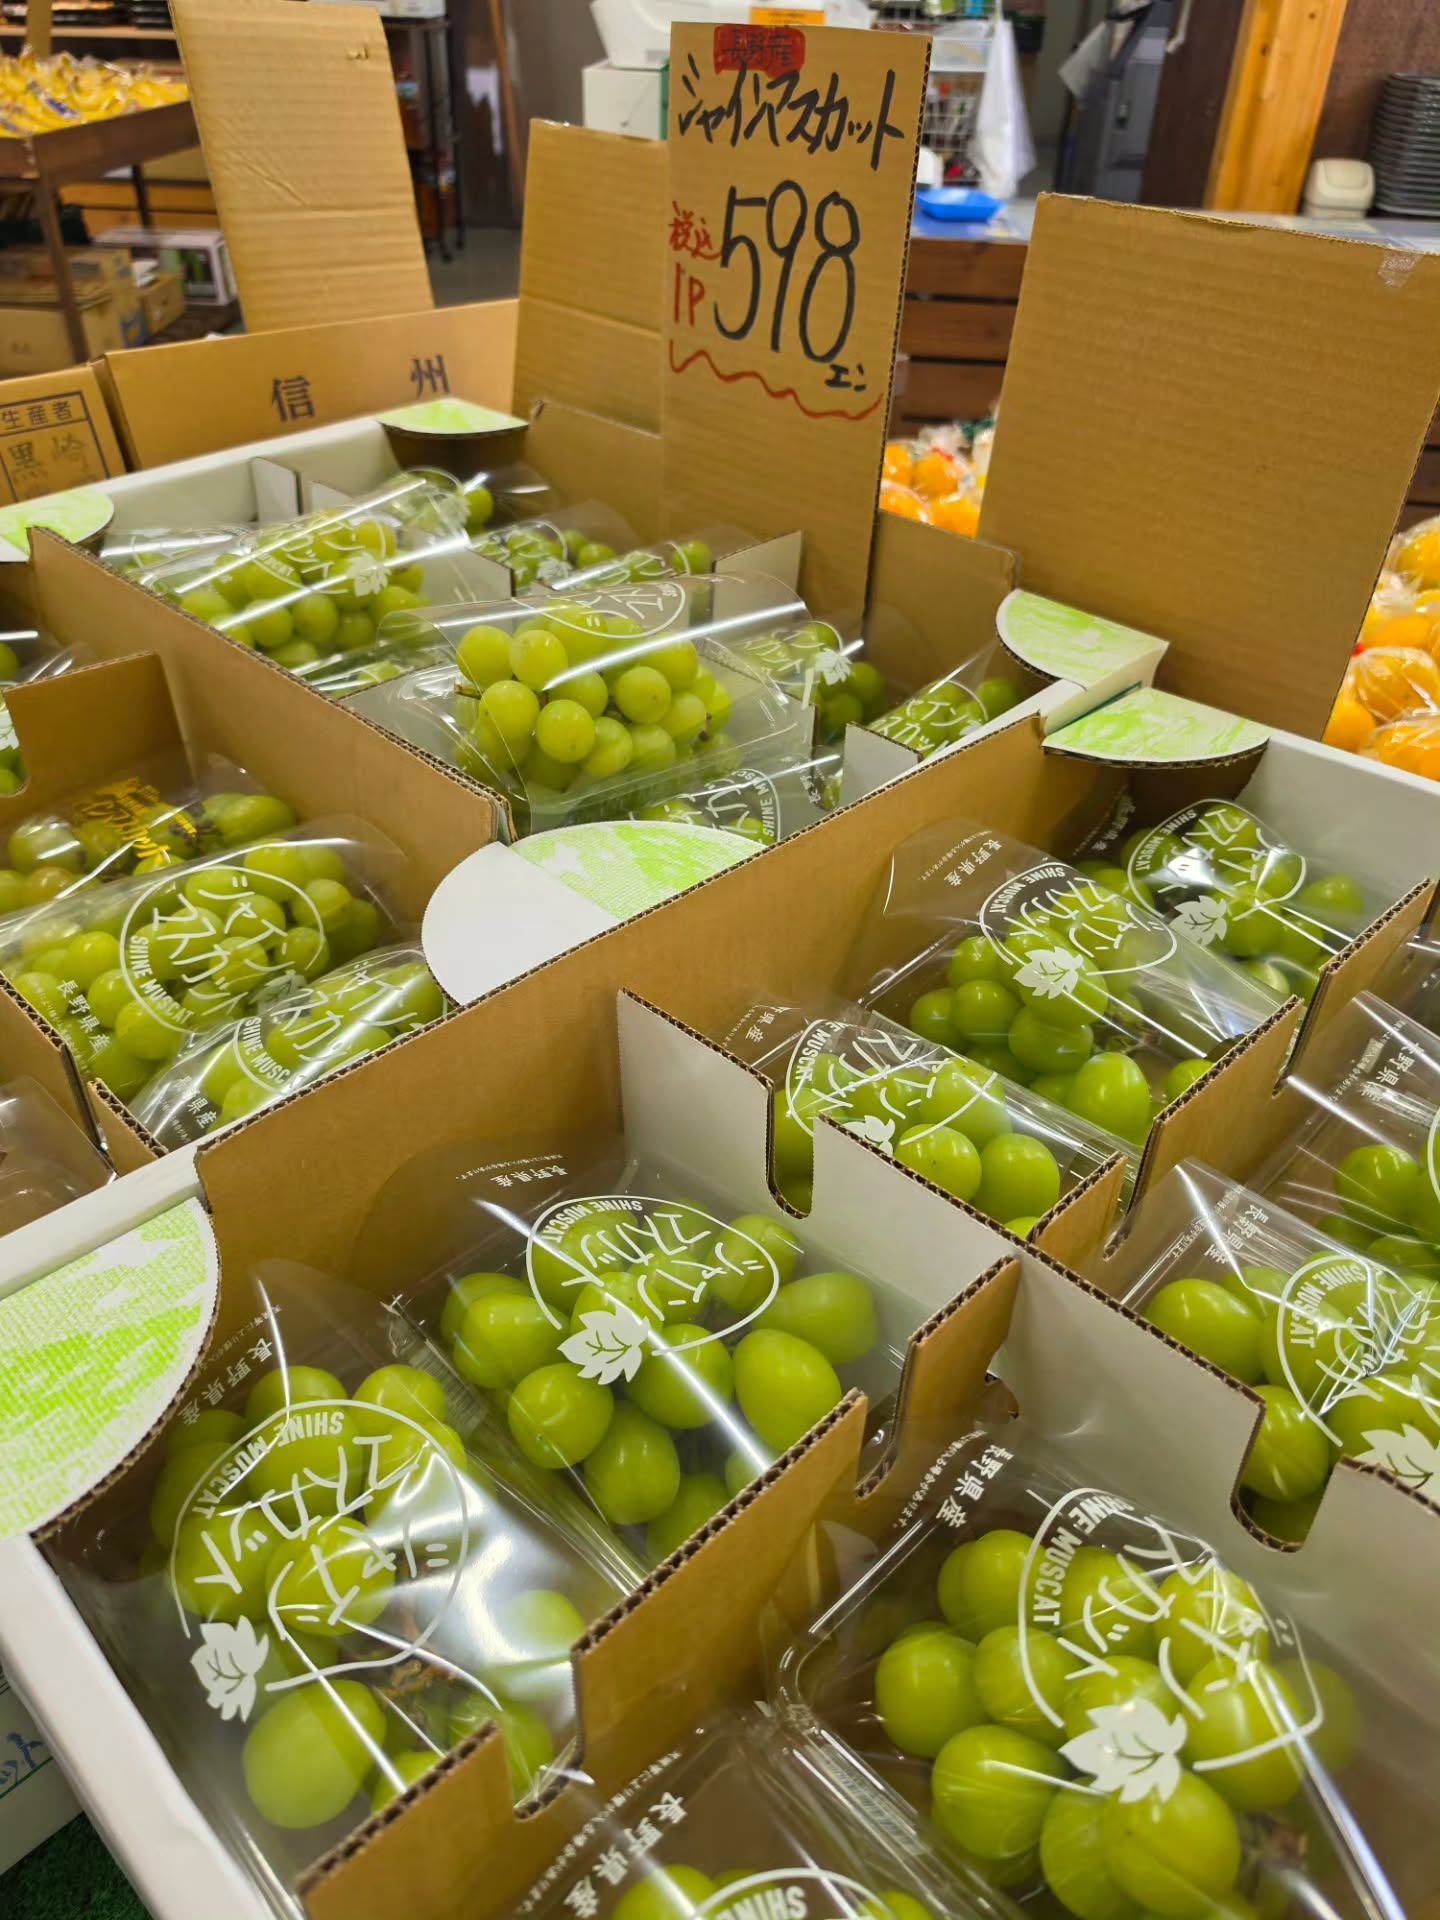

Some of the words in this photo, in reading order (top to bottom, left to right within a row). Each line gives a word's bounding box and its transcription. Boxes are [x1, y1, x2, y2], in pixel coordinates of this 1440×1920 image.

[677, 53, 905, 171] シャインマスカット
[668, 201, 723, 260] 税込
[714, 179, 860, 364] 598
[2, 400, 72, 431] 生産者
[1160, 809, 1197, 836] SHINE
[943, 839, 1003, 887] 長野県産
[1024, 867, 1066, 884] SHINE
[1135, 836, 1165, 871] MUSCAT
[198, 875, 296, 971] シャイン
[989, 882, 1027, 914] MUSCAT
[1004, 877, 1120, 937] マスカット
[129, 935, 153, 979] SHINE
[152, 893, 248, 1016] マスカット
[1068, 903, 1164, 958] シャイン
[56, 979, 111, 1053] 長野県産
[140, 978, 194, 1024] MUSCAT
[243, 1016, 264, 1055] SHINE
[251, 1053, 302, 1087] MUSC
[173, 1075, 217, 1129] 長県産
[490, 1165, 568, 1187] 長野県産
[541, 1203, 594, 1244] MUSCAT
[590, 1199, 643, 1213] SHINE
[561, 1211, 712, 1288] マスカット
[1312, 1265, 1366, 1291] SHINE
[637, 1241, 765, 1322] シャイン
[179, 1338, 273, 1426] 長野県産
[273, 1411, 345, 1448] SHINE
[192, 1436, 271, 1520] MUSCAT
[935, 1444, 1015, 1528] 長野県産
[194, 1434, 419, 1594] マスカット
[268, 1508, 449, 1640] シャイン
[1033, 1526, 1082, 1626] MUSCAT
[1057, 1516, 1216, 1680] スカット
[563, 1791, 688, 1919] 長野県産
